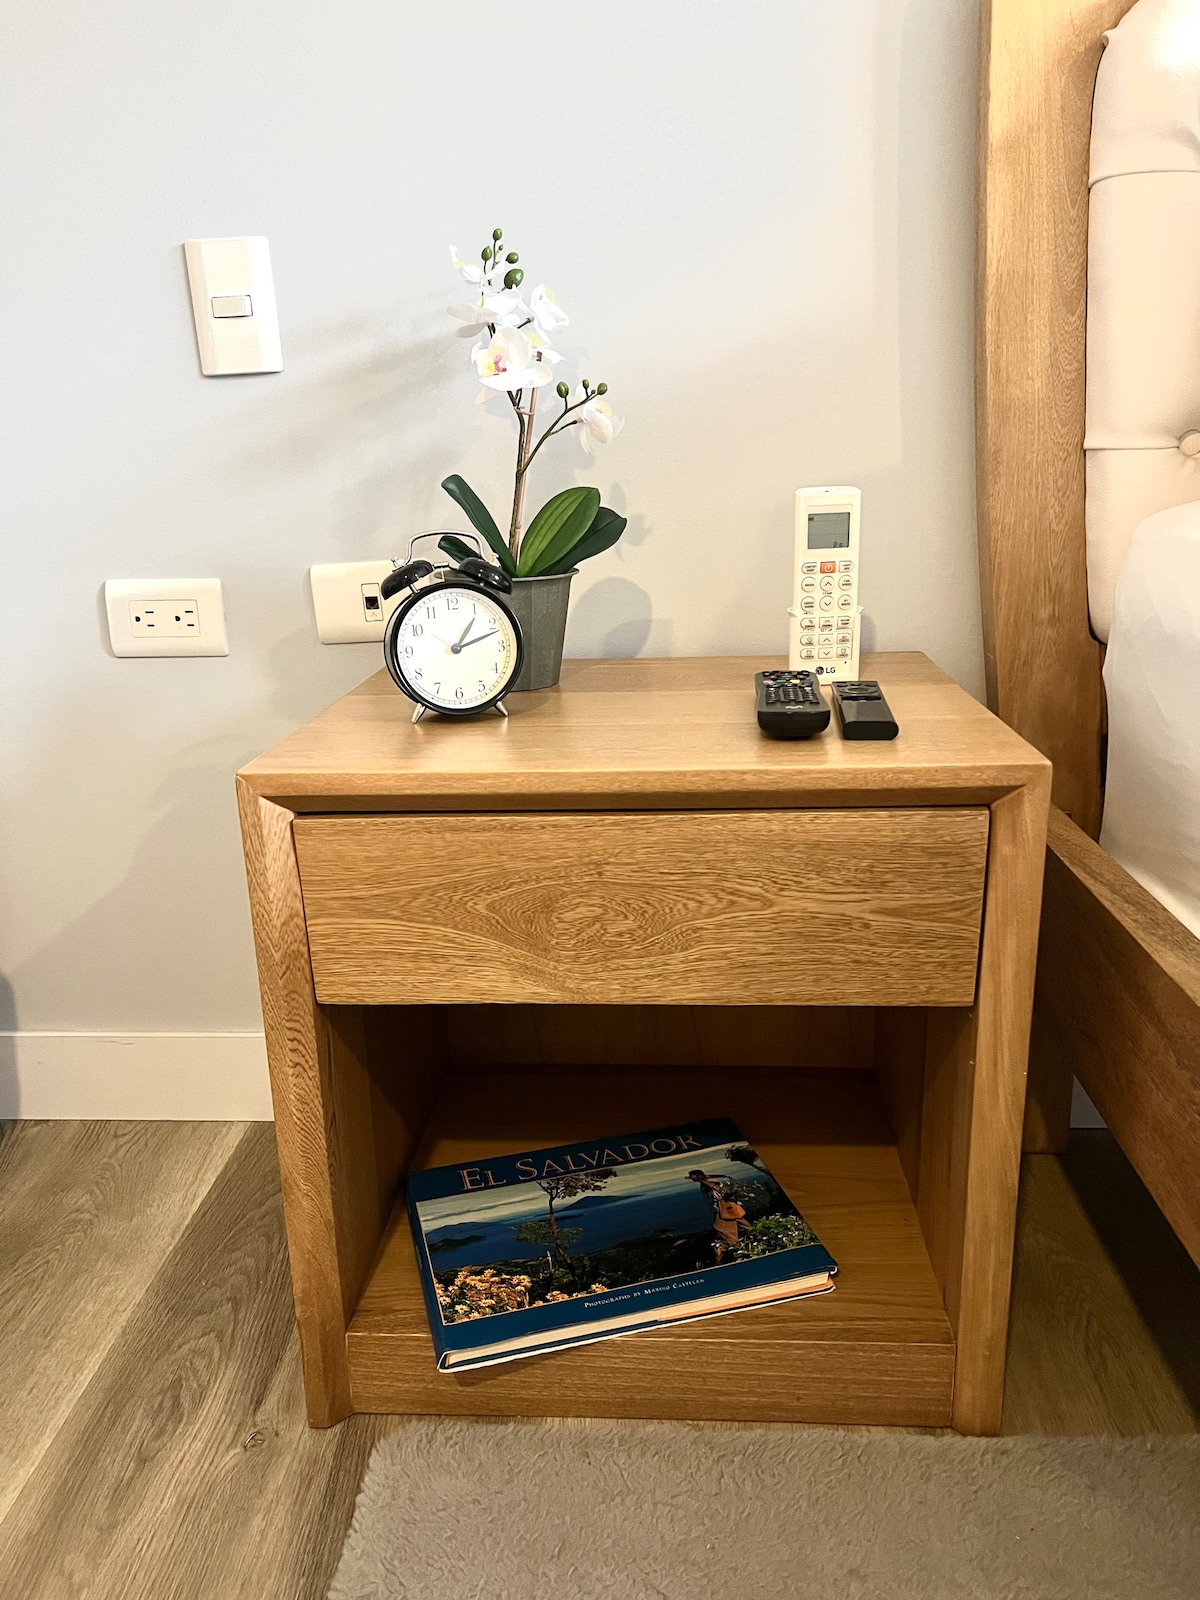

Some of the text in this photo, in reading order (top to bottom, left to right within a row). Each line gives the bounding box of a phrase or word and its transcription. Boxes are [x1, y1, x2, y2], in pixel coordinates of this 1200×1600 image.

[446, 597, 459, 611] 12
[472, 602, 477, 615] 1
[426, 606, 436, 619] 11
[488, 617, 497, 630] 2
[411, 624, 424, 637] 10
[404, 645, 414, 658] 9
[497, 640, 506, 652] 3
[414, 667, 423, 681] 8
[491, 662, 498, 674] 4
[825, 666, 836, 674] LG
[433, 682, 441, 694] 7
[477, 680, 486, 692] 5
[455, 687, 464, 699] 6
[457, 1133, 702, 1191] EL SALVADOR
[583, 1294, 631, 1308] PHOTOGRAPHS
